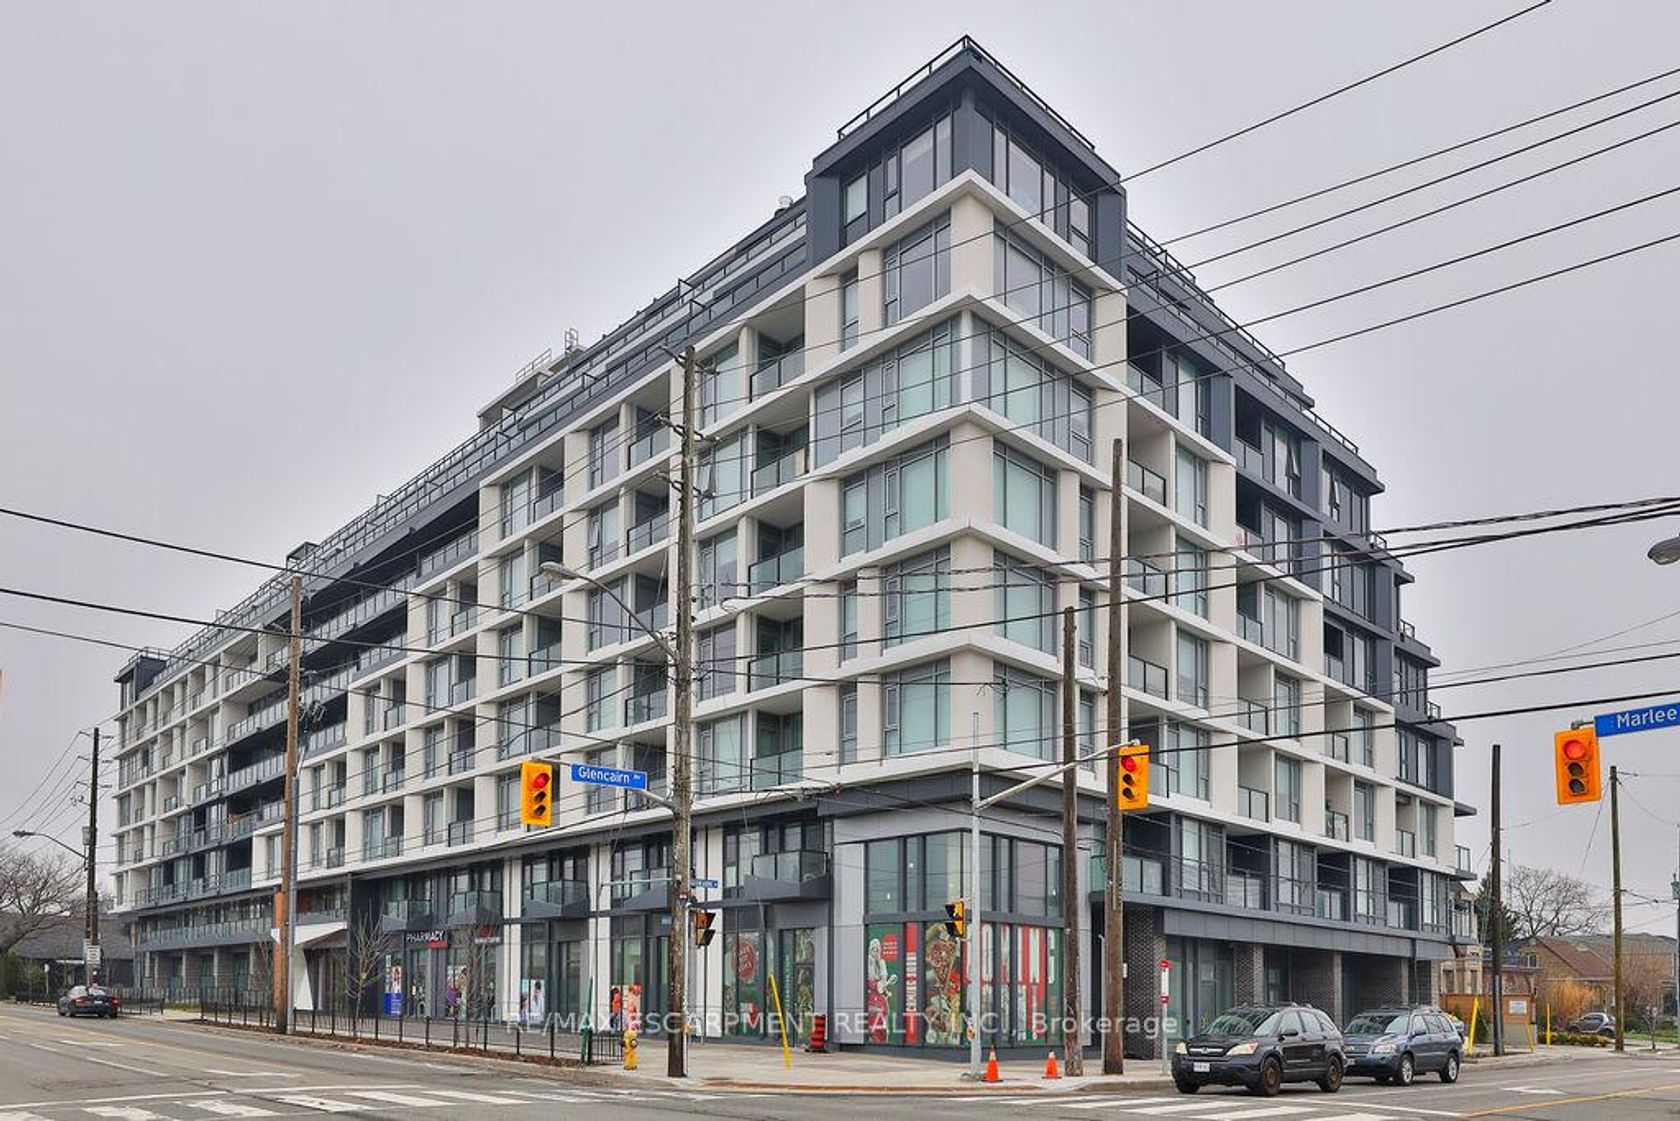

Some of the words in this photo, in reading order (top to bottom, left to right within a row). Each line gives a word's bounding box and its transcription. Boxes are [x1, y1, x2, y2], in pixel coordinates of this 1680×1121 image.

[1616, 708, 1678, 729] Marlee
[578, 765, 630, 784] Glencairn
[406, 928, 447, 943] PHARMACY
